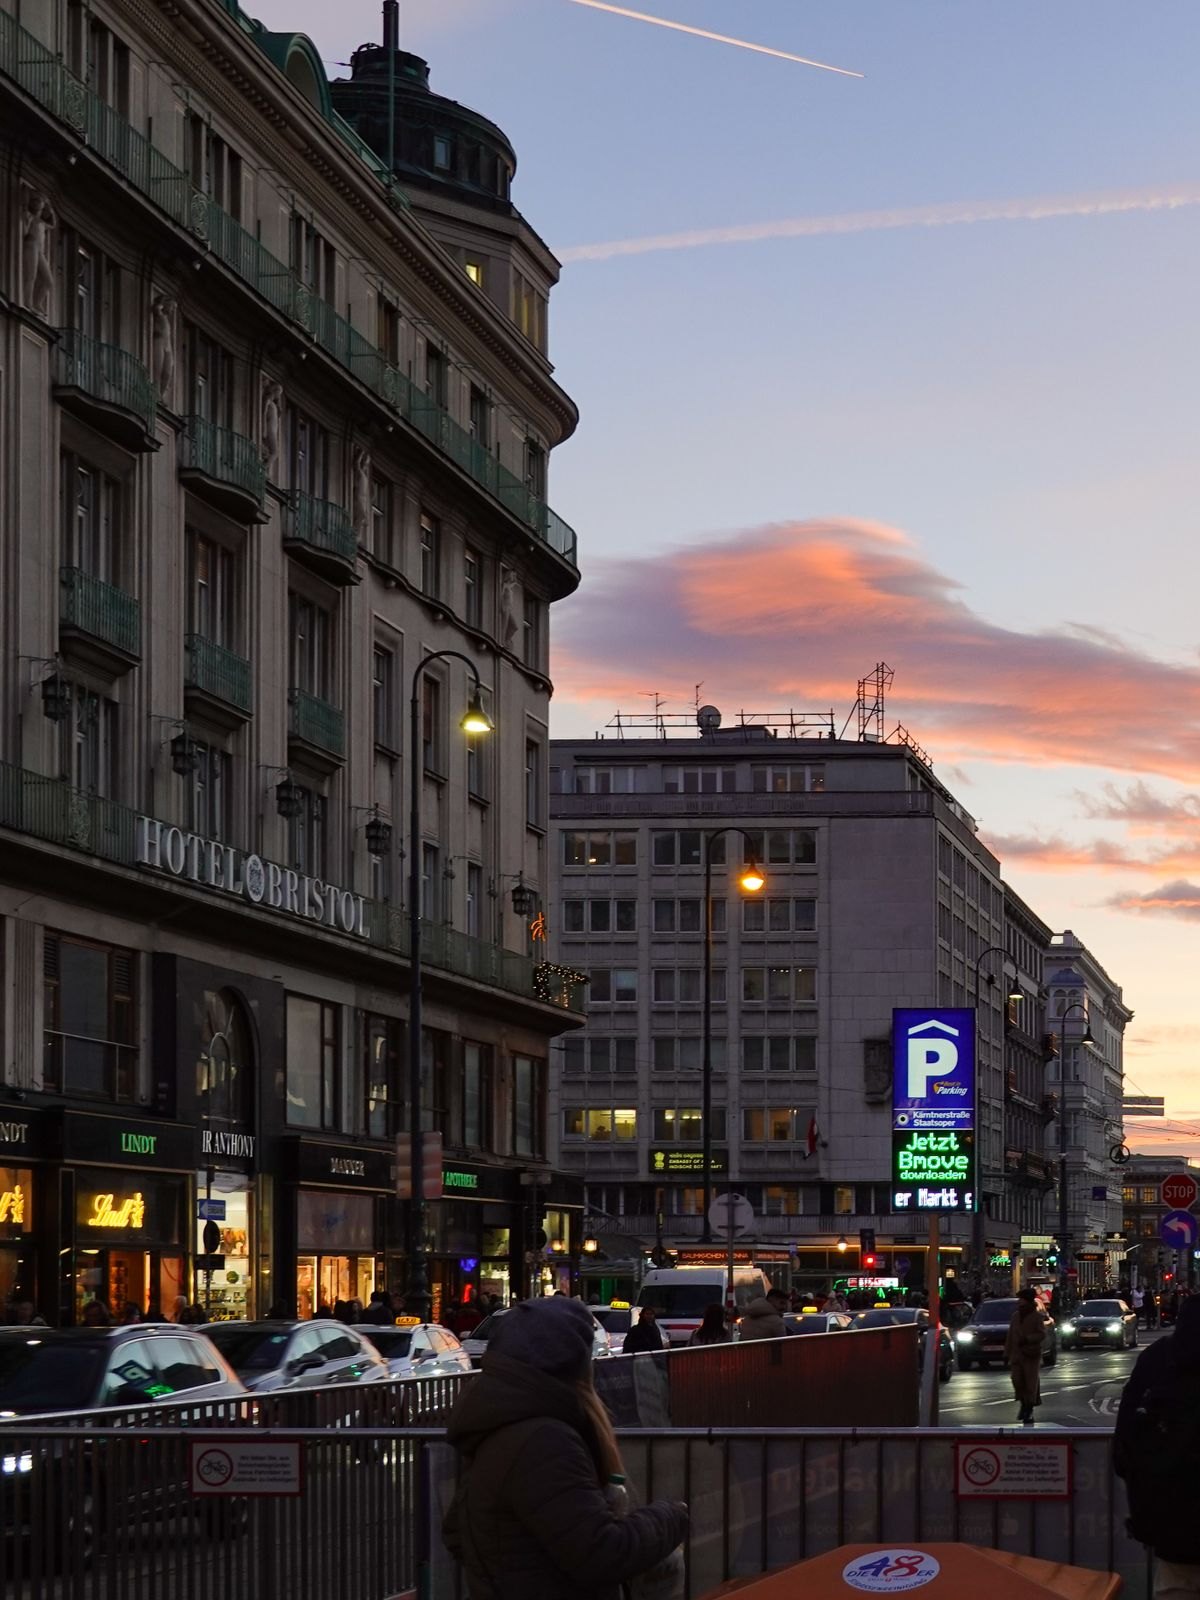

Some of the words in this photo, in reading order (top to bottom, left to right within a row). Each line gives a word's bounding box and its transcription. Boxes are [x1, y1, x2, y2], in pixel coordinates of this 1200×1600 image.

[137, 815, 244, 895] HOTEL
[266, 862, 371, 938] BRISTOL
[908, 1038, 959, 1098] P
[936, 1086, 968, 1096] Parking
[913, 1111, 970, 1119] Kärntnerstraße
[913, 1119, 956, 1128] Staatsoper
[121, 1132, 157, 1154] LINDT
[213, 1131, 256, 1158] ANTHONY
[906, 1132, 960, 1151] Jetzt
[330, 1157, 365, 1176] MANNER
[898, 1151, 969, 1170] Bmove
[445, 1171, 478, 1188] APOTHEKE
[900, 1170, 967, 1180] downloaden
[918, 1188, 958, 1207] Markt
[1165, 1185, 1194, 1198] STOP
[88, 1193, 134, 1227] Lindt
